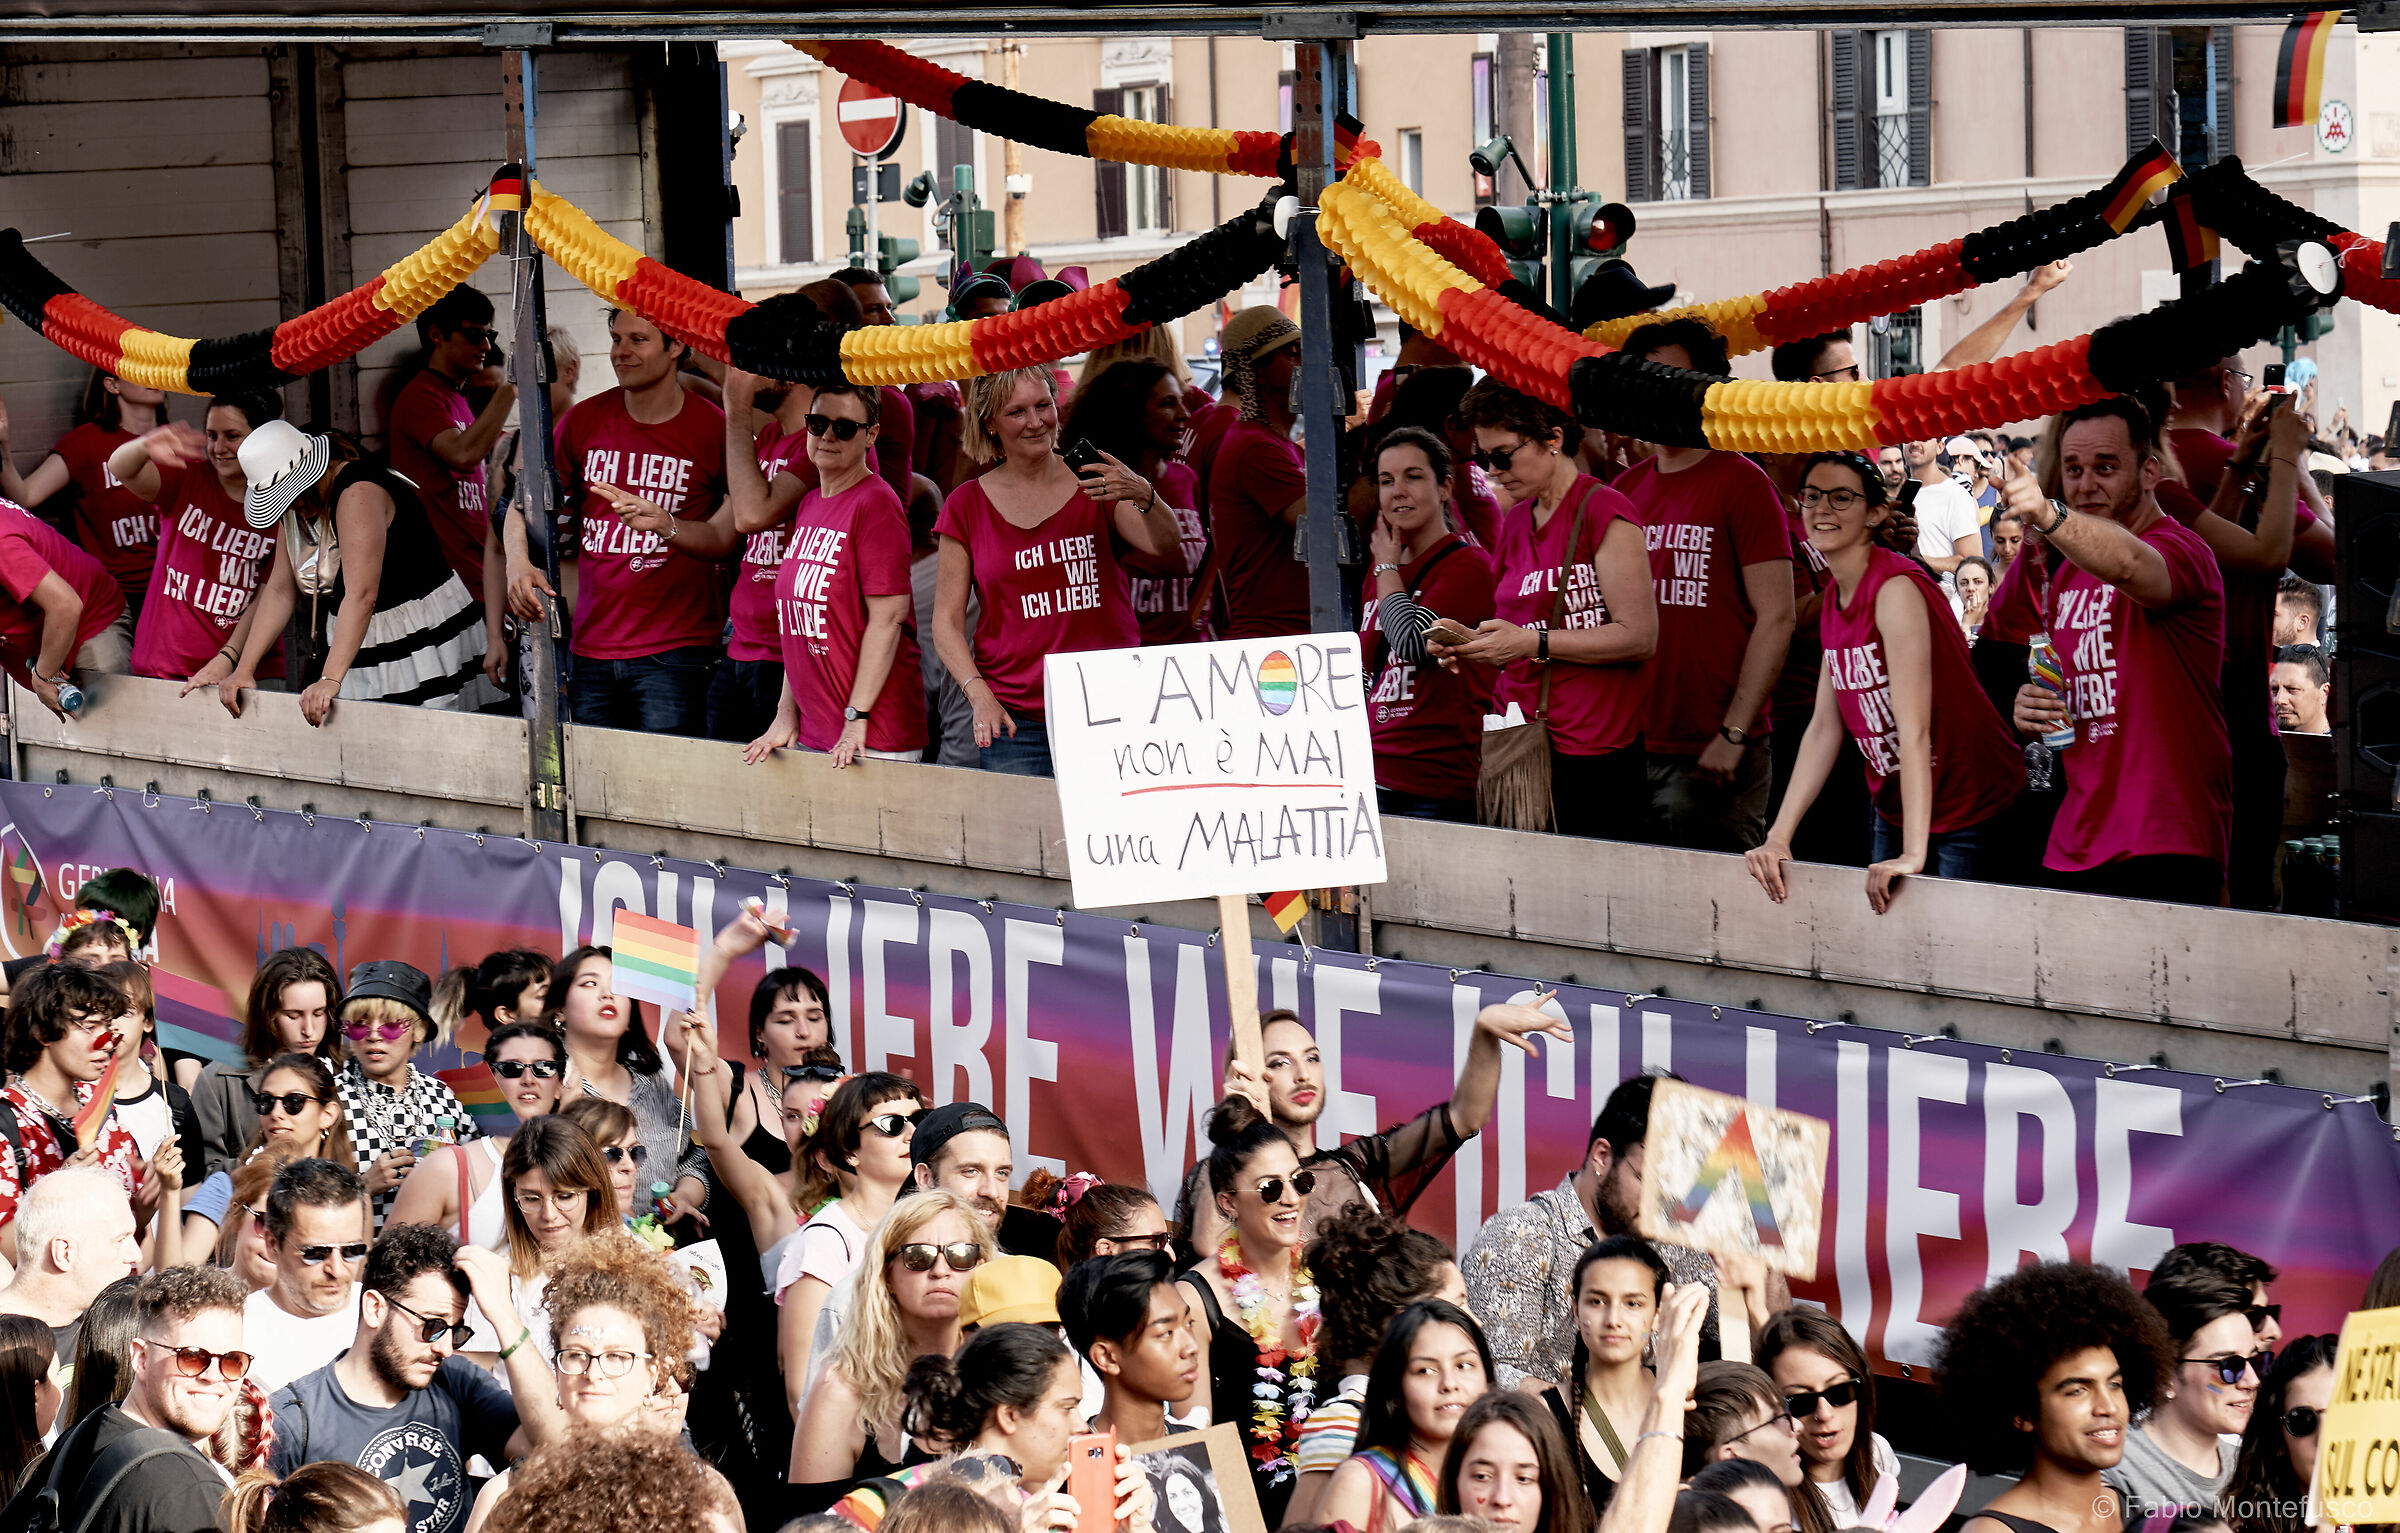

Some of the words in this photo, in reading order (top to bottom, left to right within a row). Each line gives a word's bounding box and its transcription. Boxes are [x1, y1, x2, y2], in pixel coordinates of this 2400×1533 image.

[584, 449, 621, 484] ICH
[627, 452, 693, 492] LIEBE
[458, 480, 483, 511] ICH
[112, 514, 149, 548] ICH
[178, 503, 213, 543] ICH
[211, 521, 276, 560] LIEBE
[797, 525, 847, 566] LIEBE
[1665, 524, 1714, 552] LIEBE
[1015, 541, 1044, 570] ICH
[1049, 534, 1096, 564] LIEBE
[1674, 551, 1711, 579] WIE
[219, 554, 260, 589] WIE
[793, 562, 836, 601] WIE
[1064, 559, 1099, 585] WIE
[1518, 570, 1543, 597] ICH
[1021, 591, 1051, 619] ICH
[1056, 584, 1101, 613] LIEBE
[1131, 577, 1164, 613] ICH
[1564, 586, 1604, 613] WIE
[1660, 579, 1709, 607] LIEBE
[1564, 607, 1606, 631] IEBE
[1076, 643, 1359, 727] L'AMORE
[1824, 648, 1847, 690] CH
[1113, 740, 1192, 780] non
[1216, 728, 1235, 774] è
[1256, 730, 1344, 779] MAI
[1087, 834, 1160, 866] una
[1123, 935, 1382, 1222] WE
[415, 1498, 450, 1533] STAR
